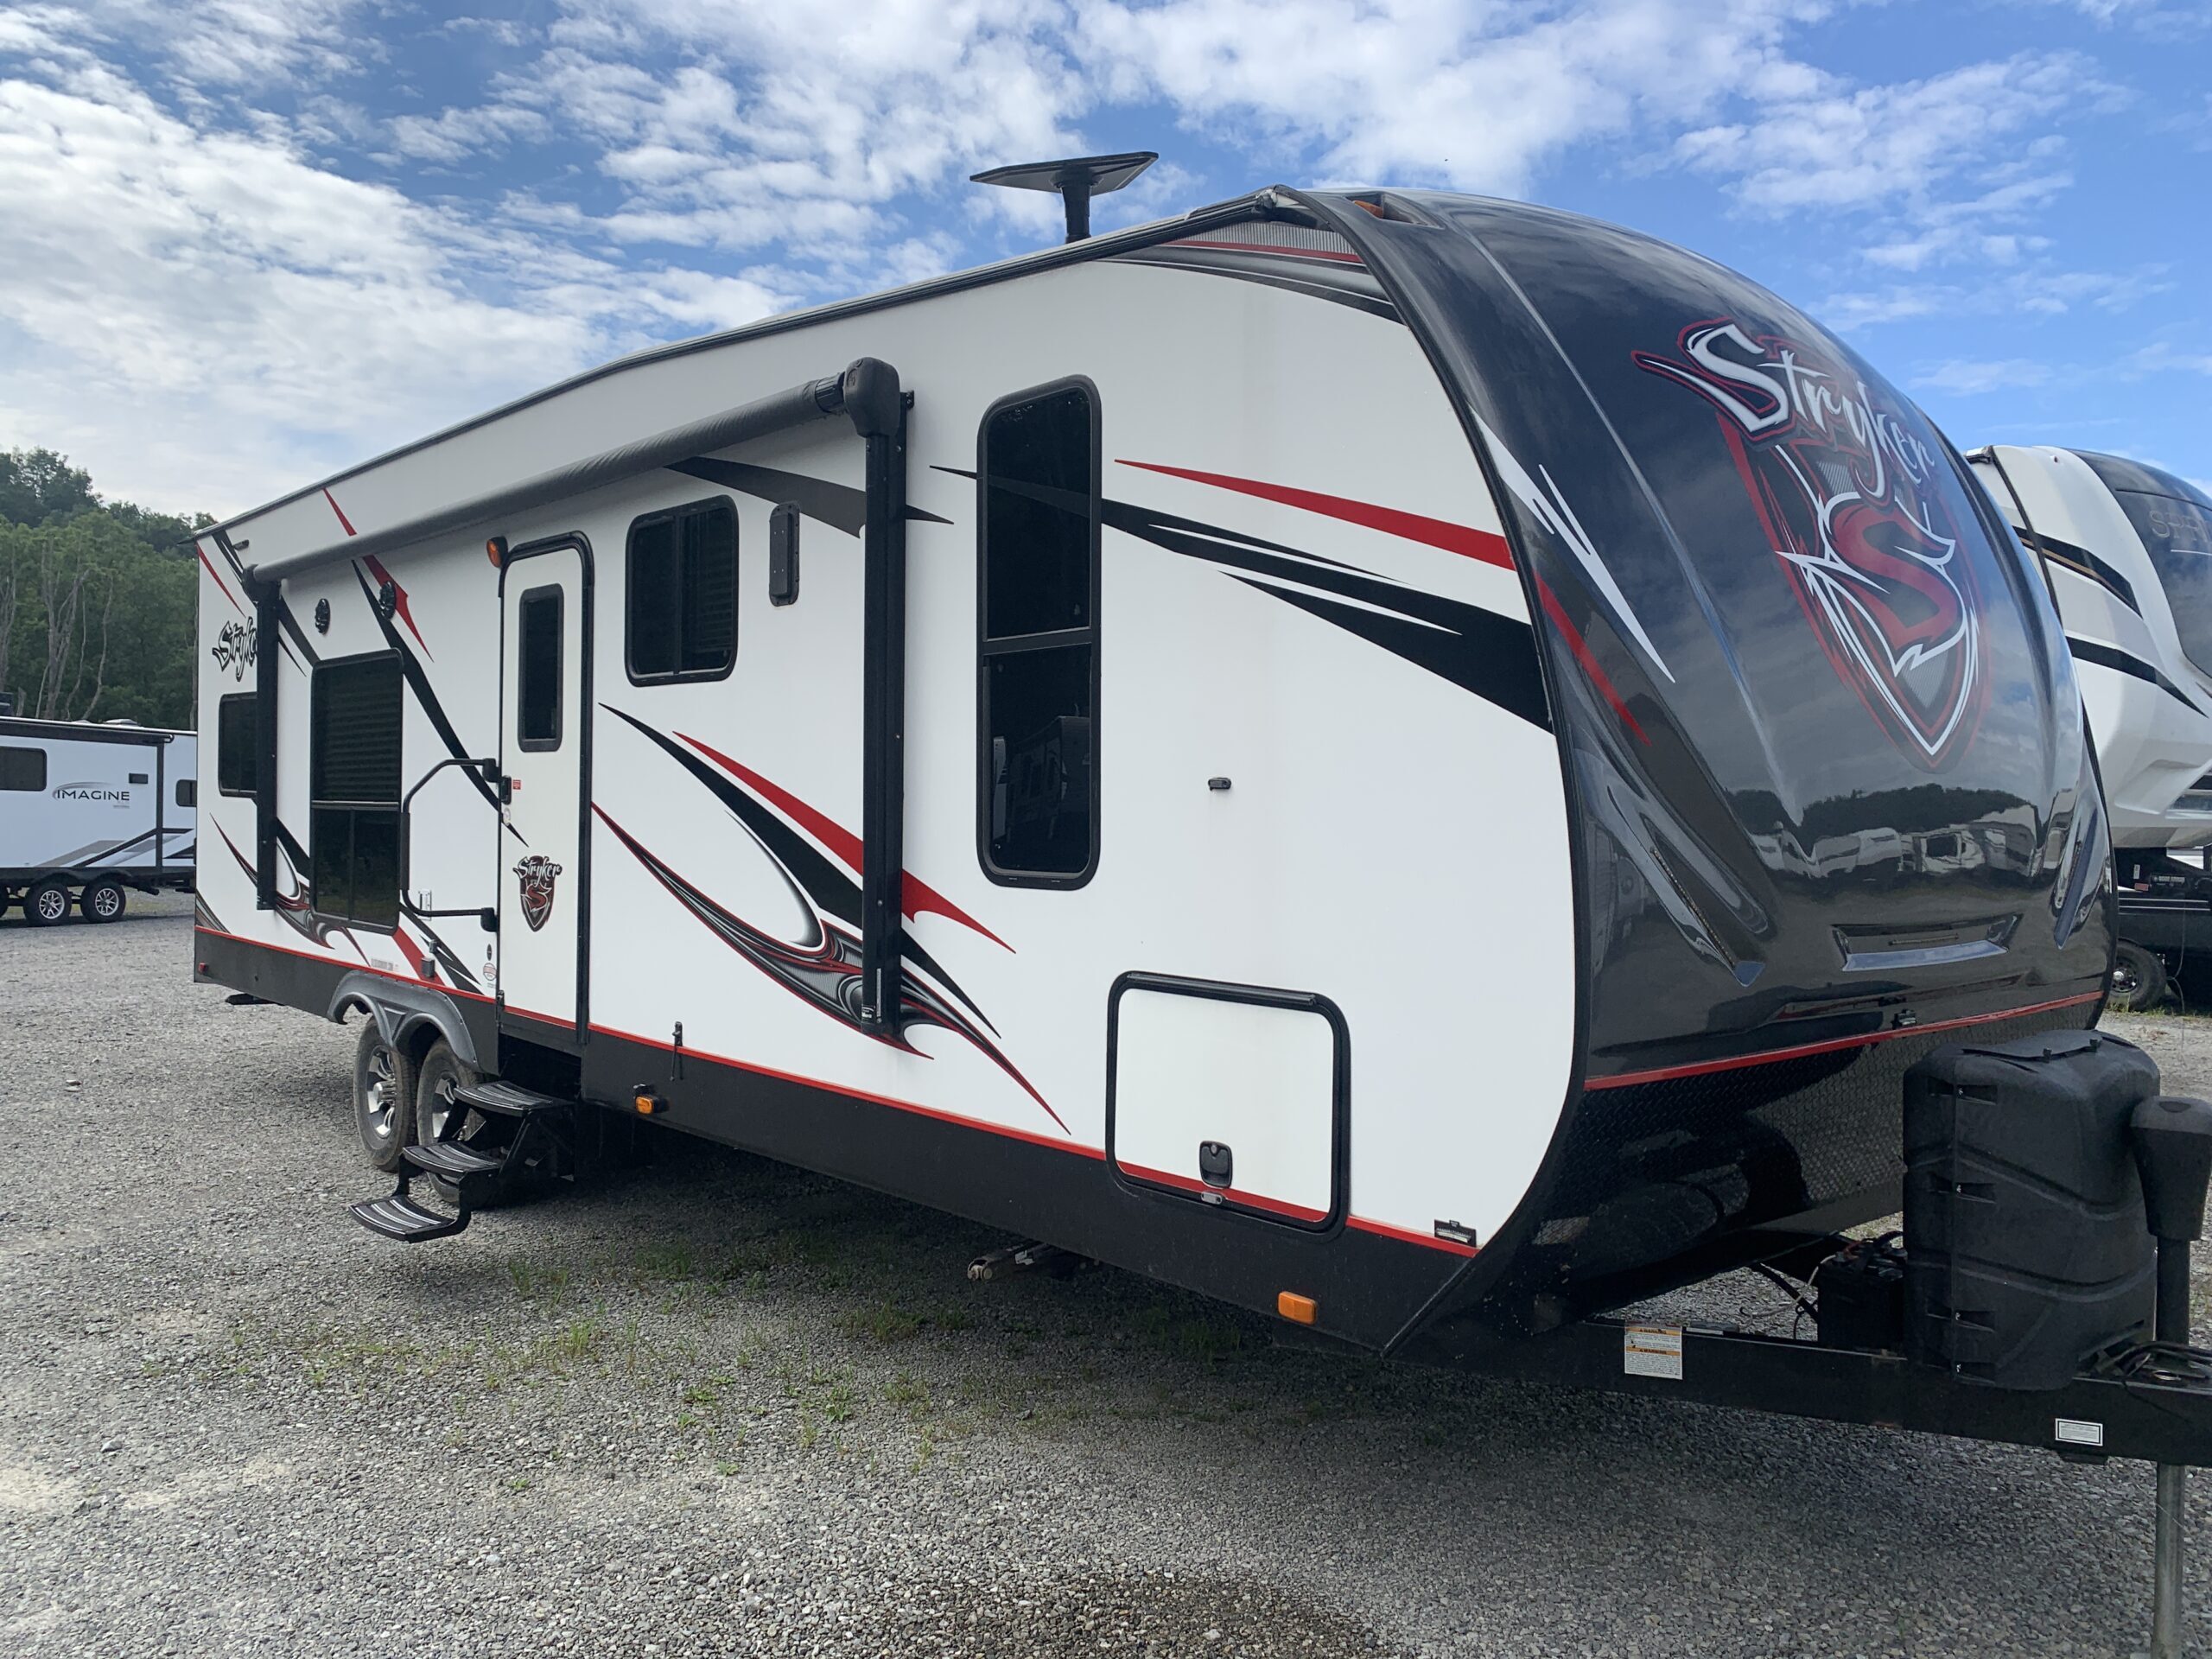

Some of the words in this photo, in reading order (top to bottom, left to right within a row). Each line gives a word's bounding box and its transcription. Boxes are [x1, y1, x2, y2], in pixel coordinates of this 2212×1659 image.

[1636, 321, 1937, 499] Stryker
[57, 788, 130, 801] IMAGINE
[512, 855, 563, 887] Stryker
